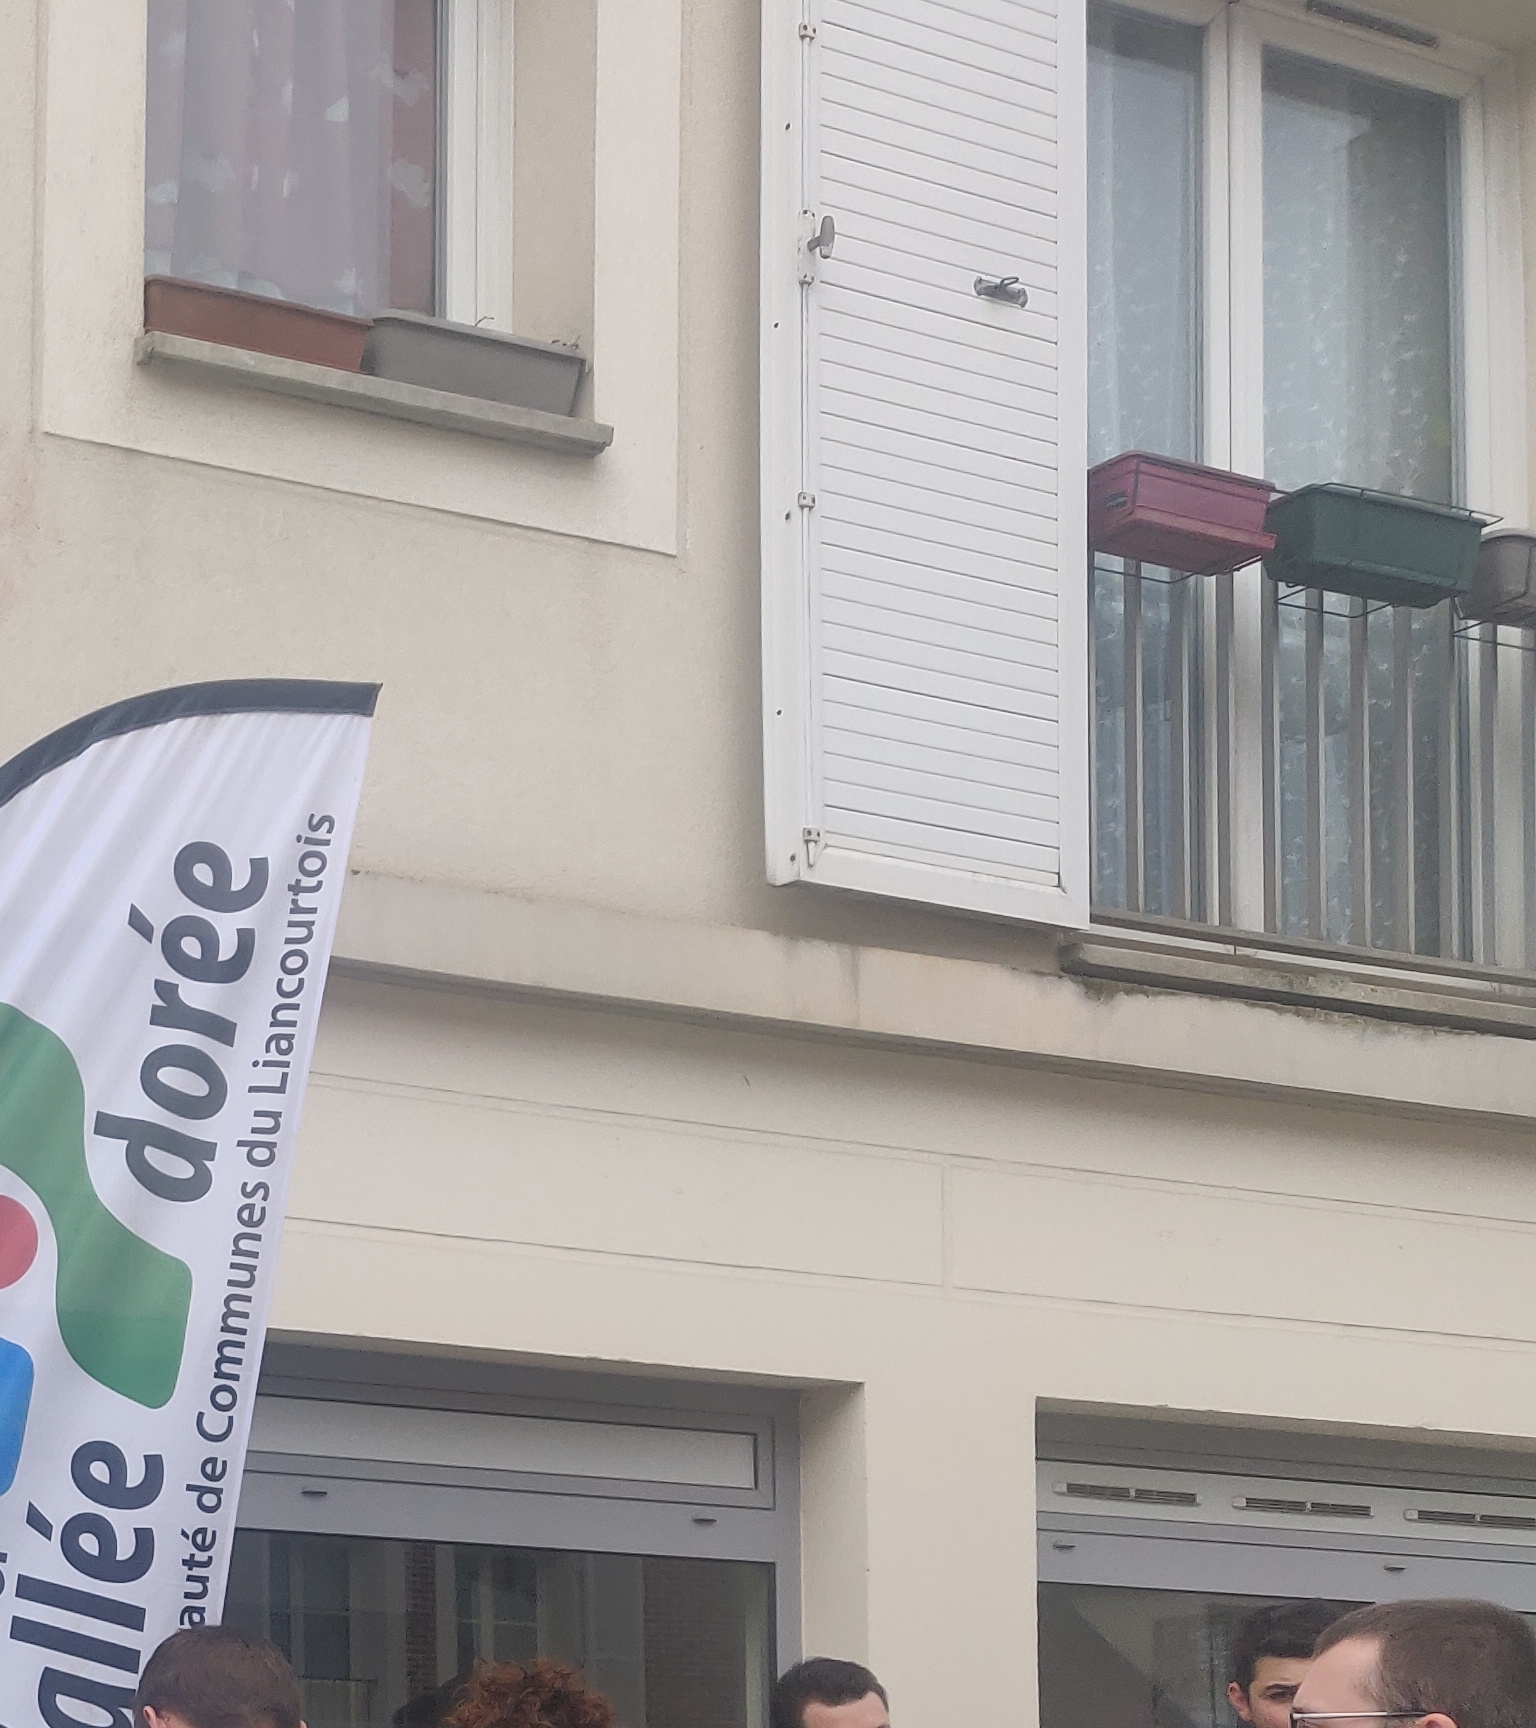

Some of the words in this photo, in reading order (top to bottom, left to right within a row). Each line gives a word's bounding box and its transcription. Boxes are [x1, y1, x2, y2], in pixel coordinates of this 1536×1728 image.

[94, 841, 269, 1202] dorée
[247, 812, 335, 1094] Liancourtois
[236, 1110, 283, 1167] du
[196, 1180, 270, 1443] Communes
[186, 1456, 227, 1514] de
[179, 1527, 217, 1628] auté
